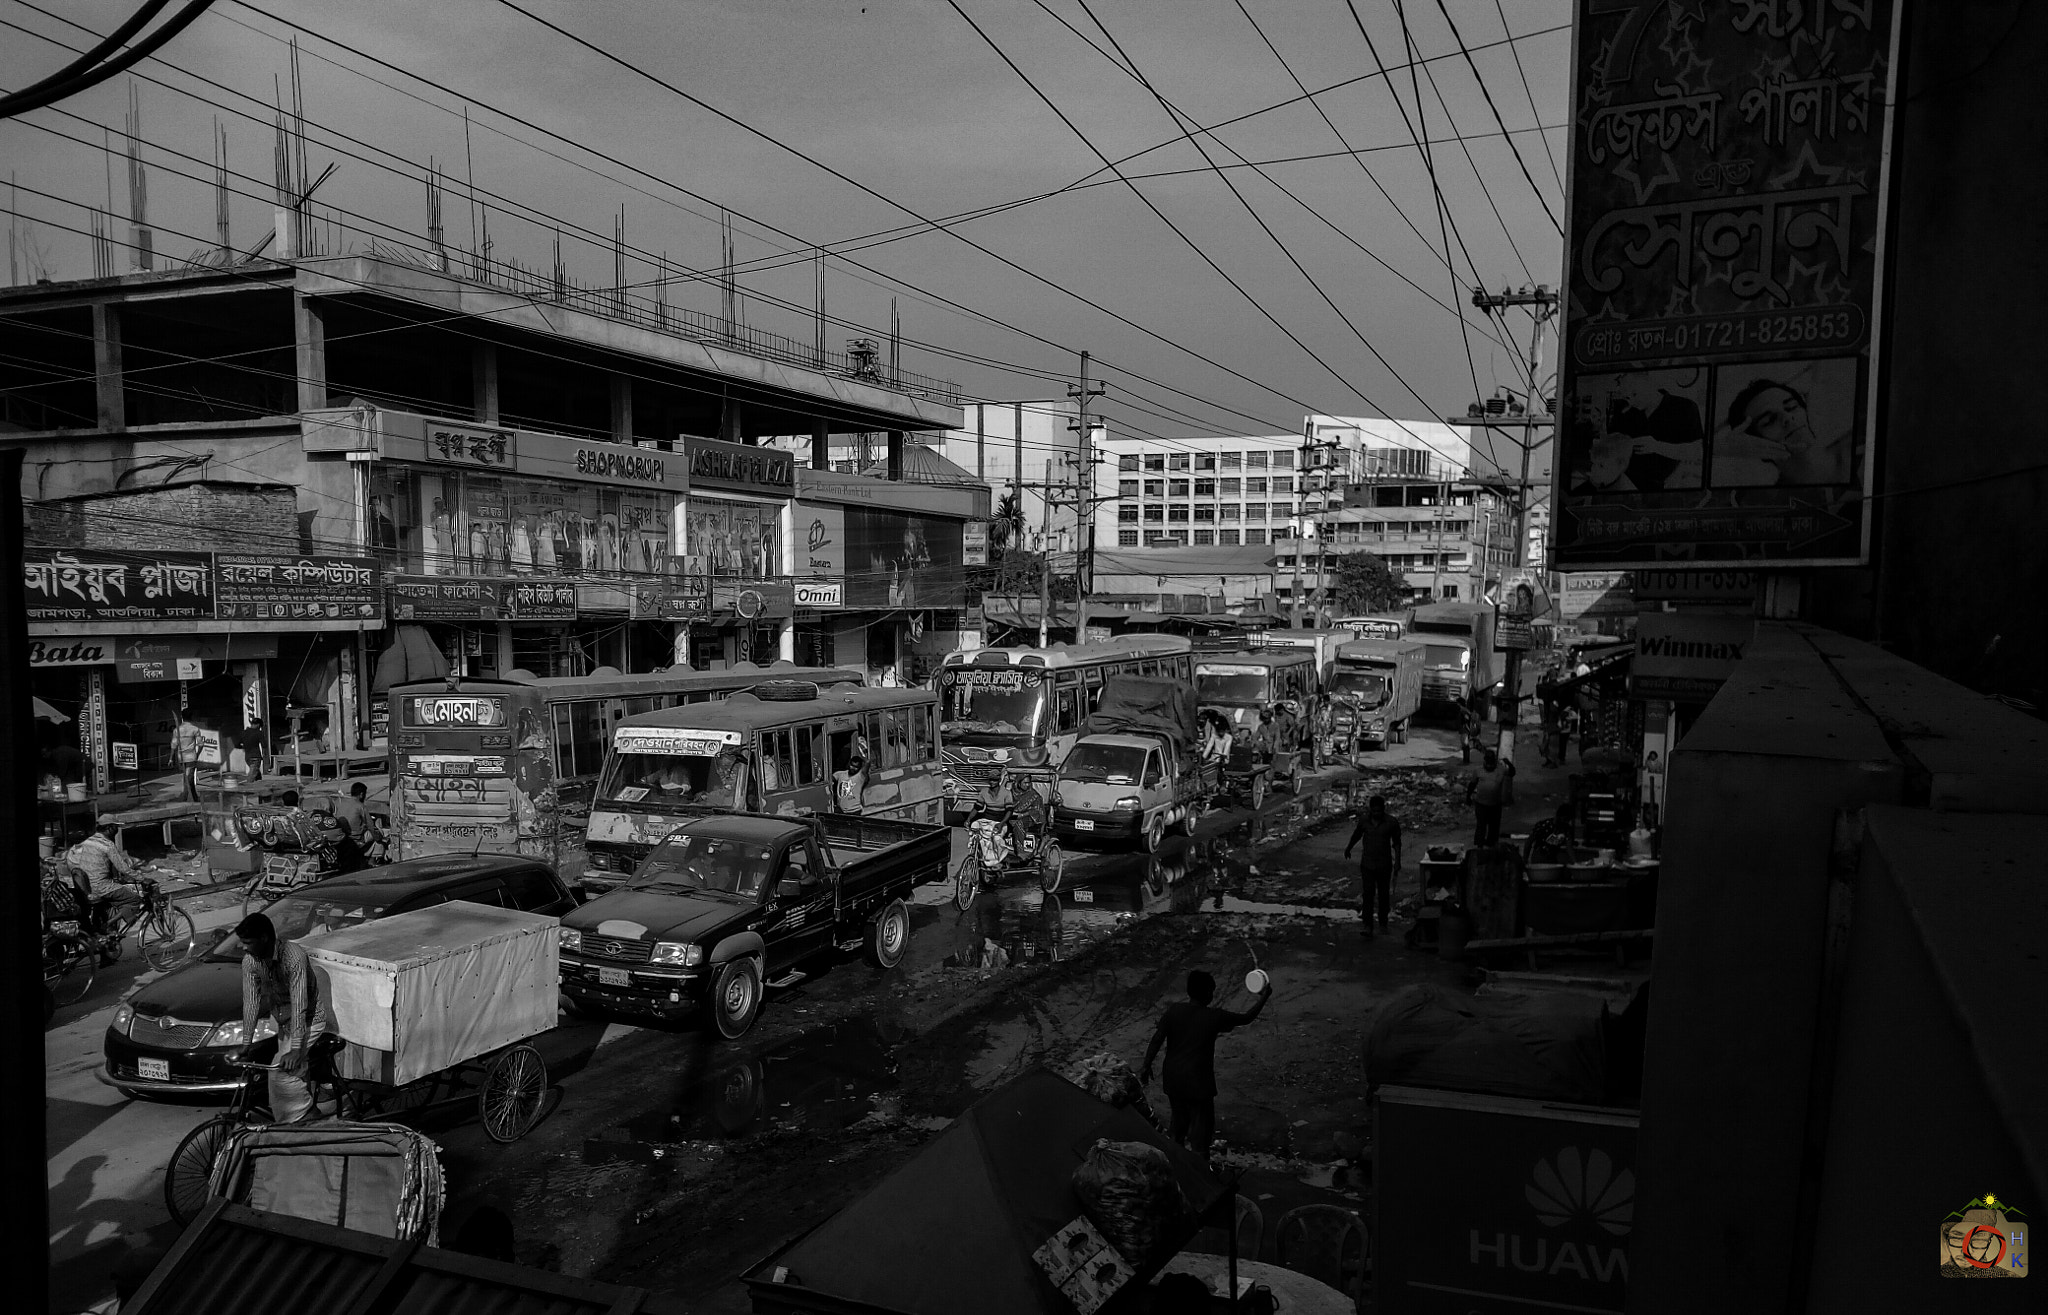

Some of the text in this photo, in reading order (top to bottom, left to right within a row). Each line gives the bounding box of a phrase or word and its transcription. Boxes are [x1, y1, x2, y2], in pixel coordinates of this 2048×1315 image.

[1581, 182, 1870, 307] সেলুন
[577, 448, 665, 483] SHOPNORUPI
[690, 447, 793, 487] ASHRAF PLAZA
[140, 560, 210, 600] প্লাজা
[396, 582, 438, 600] ফাতেমা
[798, 588, 837, 603] Omni
[95, 605, 161, 618] আশুলিয়া,
[29, 641, 104, 664] Bata
[1640, 635, 1747, 660] Winmax
[434, 700, 478, 723] মোহনা
